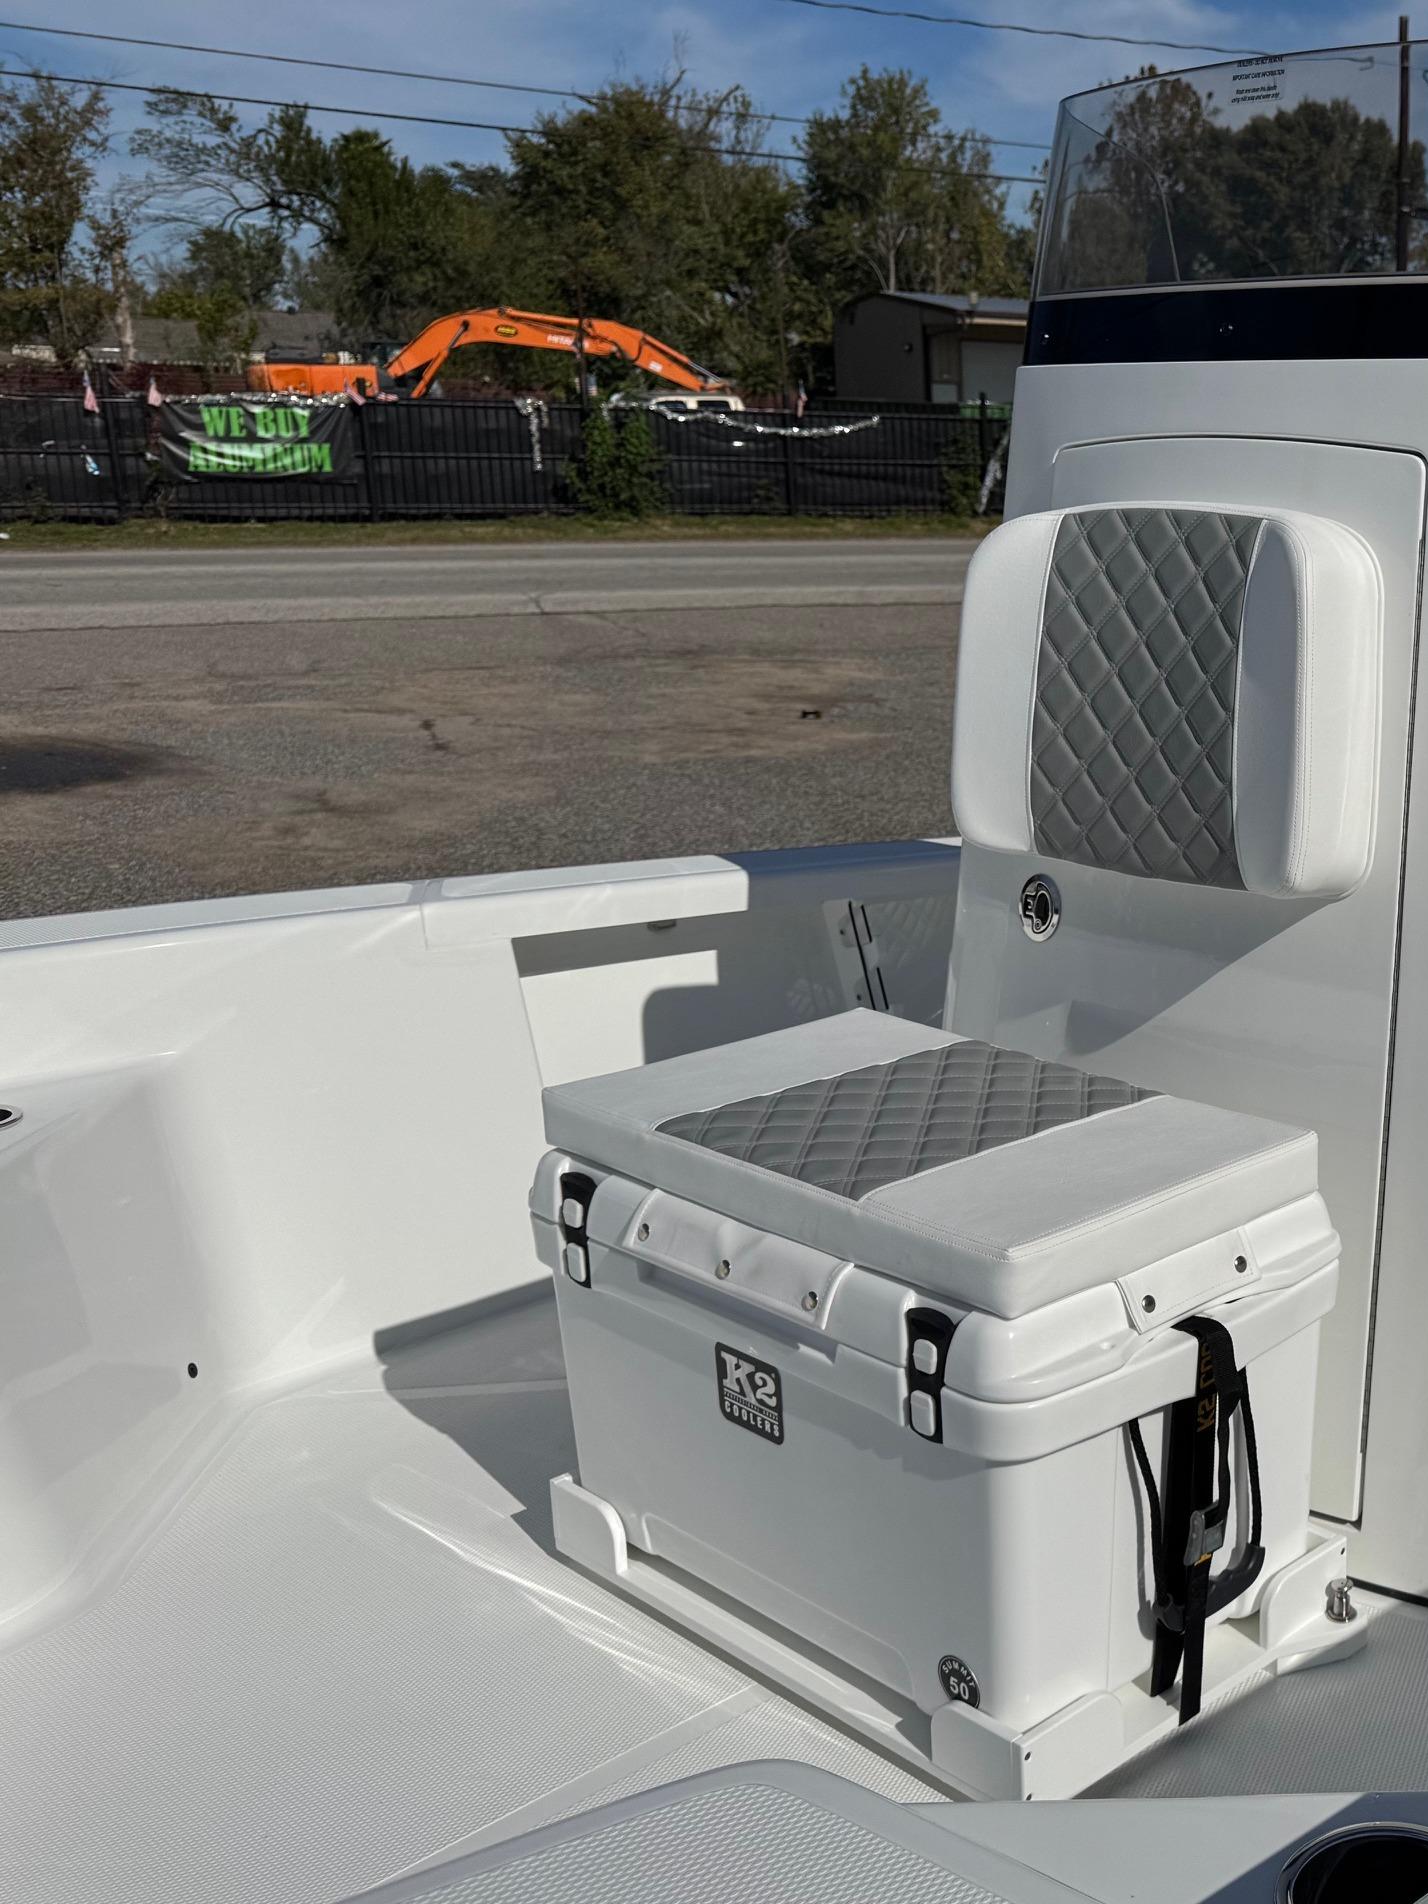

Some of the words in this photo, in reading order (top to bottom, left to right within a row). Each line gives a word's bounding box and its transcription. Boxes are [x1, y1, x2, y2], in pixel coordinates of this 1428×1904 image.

[202, 406, 248, 437] WE
[256, 408, 310, 437] BUY
[188, 442, 333, 472] ALUMINUM
[720, 1350, 777, 1407] K2
[724, 1400, 779, 1437] COOLERS
[942, 1660, 976, 1688] SUMMIT
[950, 1675, 969, 1700] 50
